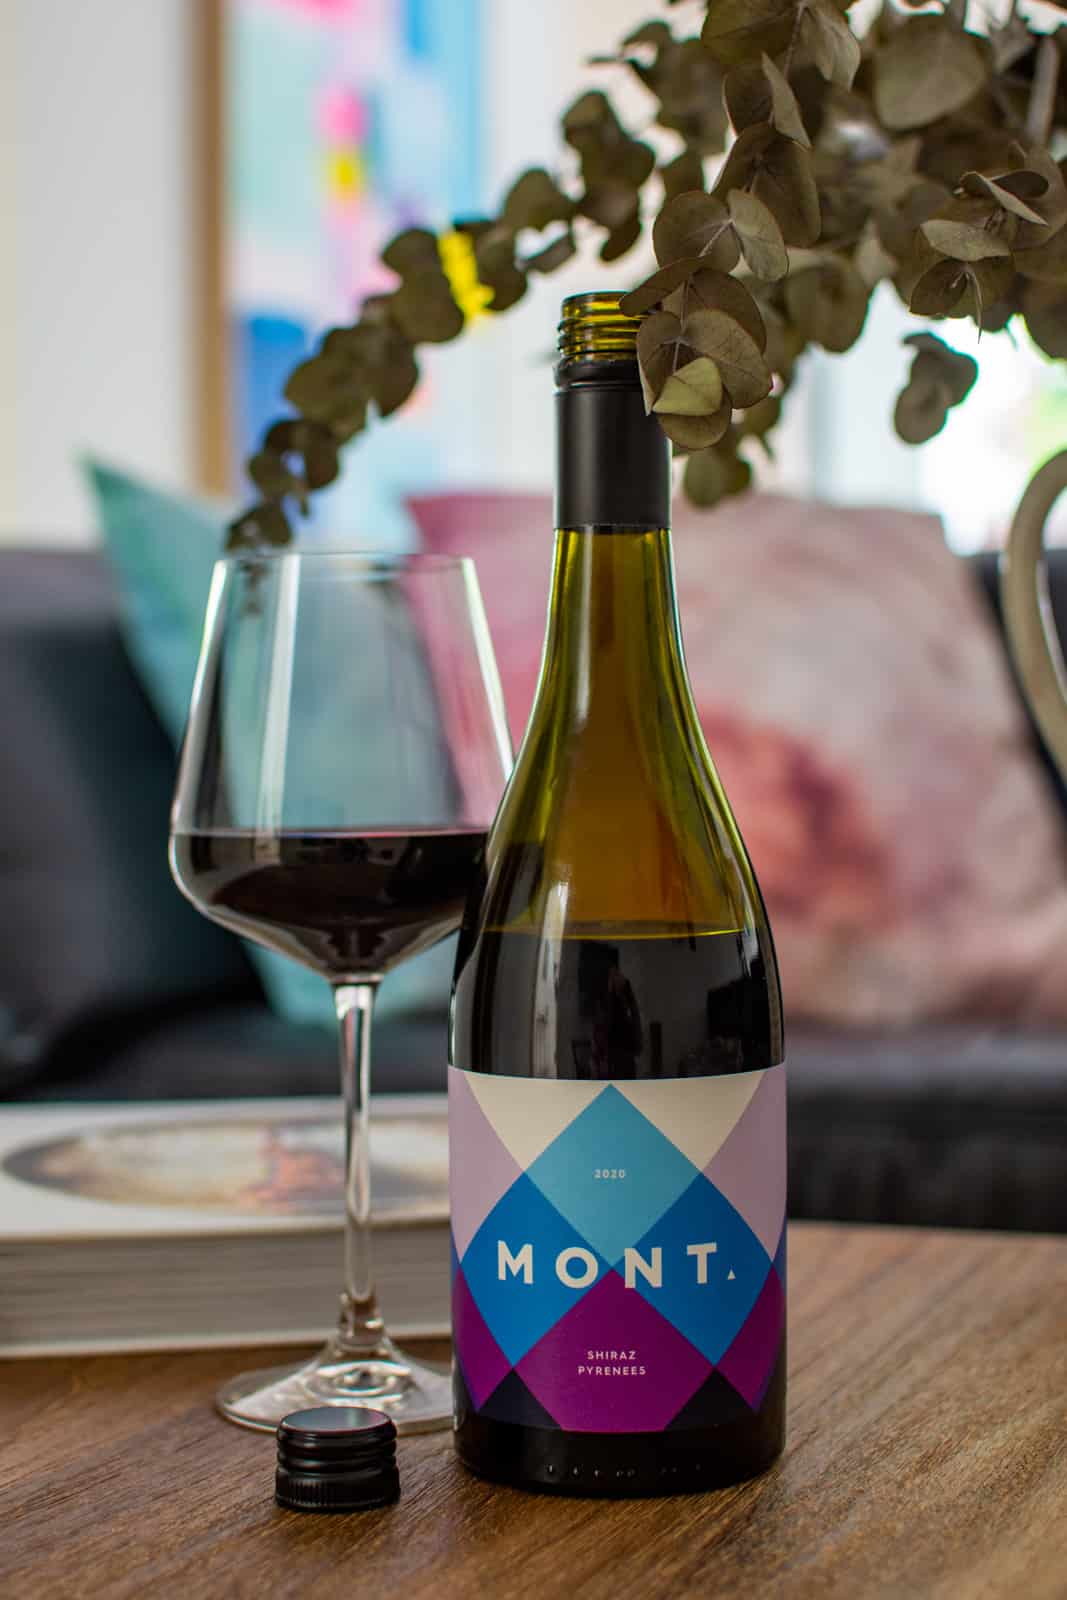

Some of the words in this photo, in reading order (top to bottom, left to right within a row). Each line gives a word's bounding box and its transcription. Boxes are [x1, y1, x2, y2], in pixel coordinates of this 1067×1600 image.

[594, 1169, 626, 1178] 2020
[587, 1350, 637, 1361] SHIRAZ
[577, 1365, 647, 1376] PYRENEES
